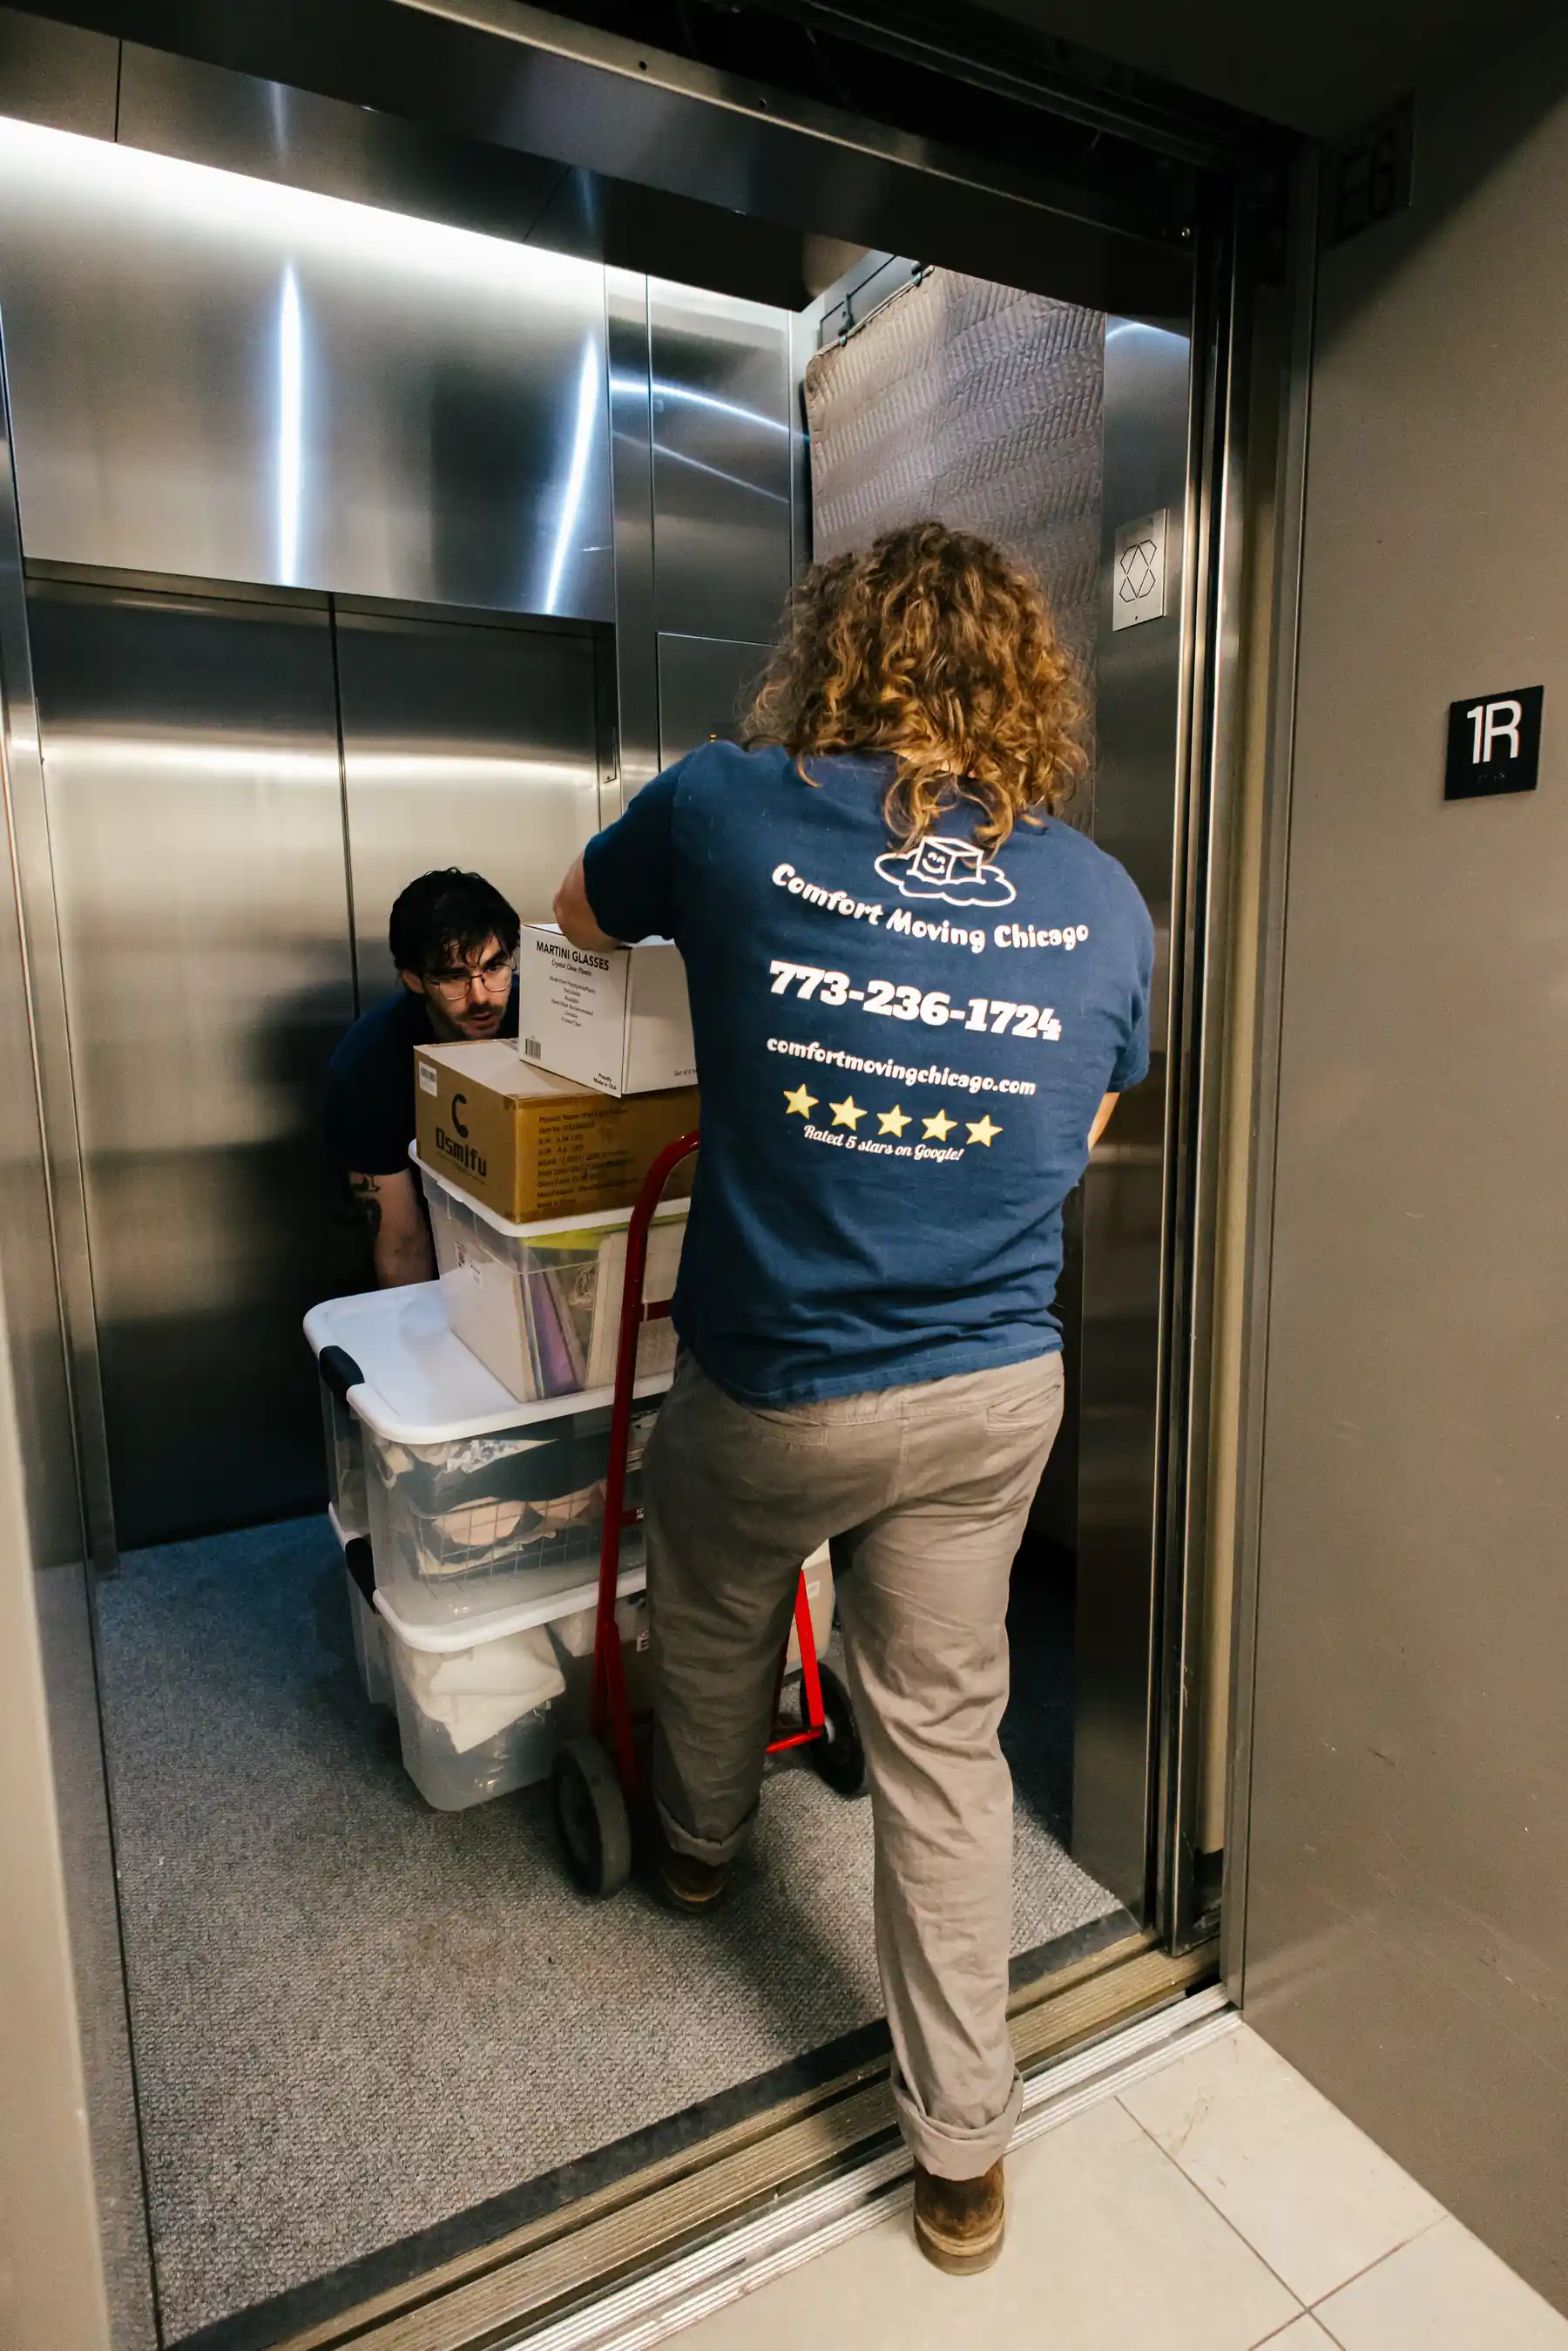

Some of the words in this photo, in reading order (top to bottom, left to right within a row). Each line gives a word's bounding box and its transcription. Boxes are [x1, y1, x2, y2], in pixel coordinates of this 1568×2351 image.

[1467, 700, 1522, 764] 1R
[772, 863, 883, 925] Comfort
[886, 908, 986, 953] Moving
[994, 924, 1089, 951] Chicago
[537, 940, 570, 959] MARTINI
[571, 951, 609, 971] GLASSES
[551, 959, 565, 969] Crystal
[769, 959, 1062, 1041] 773-236-1724
[767, 1037, 1037, 1095] comfortmovingchicago.com
[804, 1125, 843, 1148] Rated
[846, 1135, 856, 1148] 5
[858, 1140, 893, 1155] stars
[895, 1145, 913, 1158] on
[914, 1144, 964, 1163] Google!
